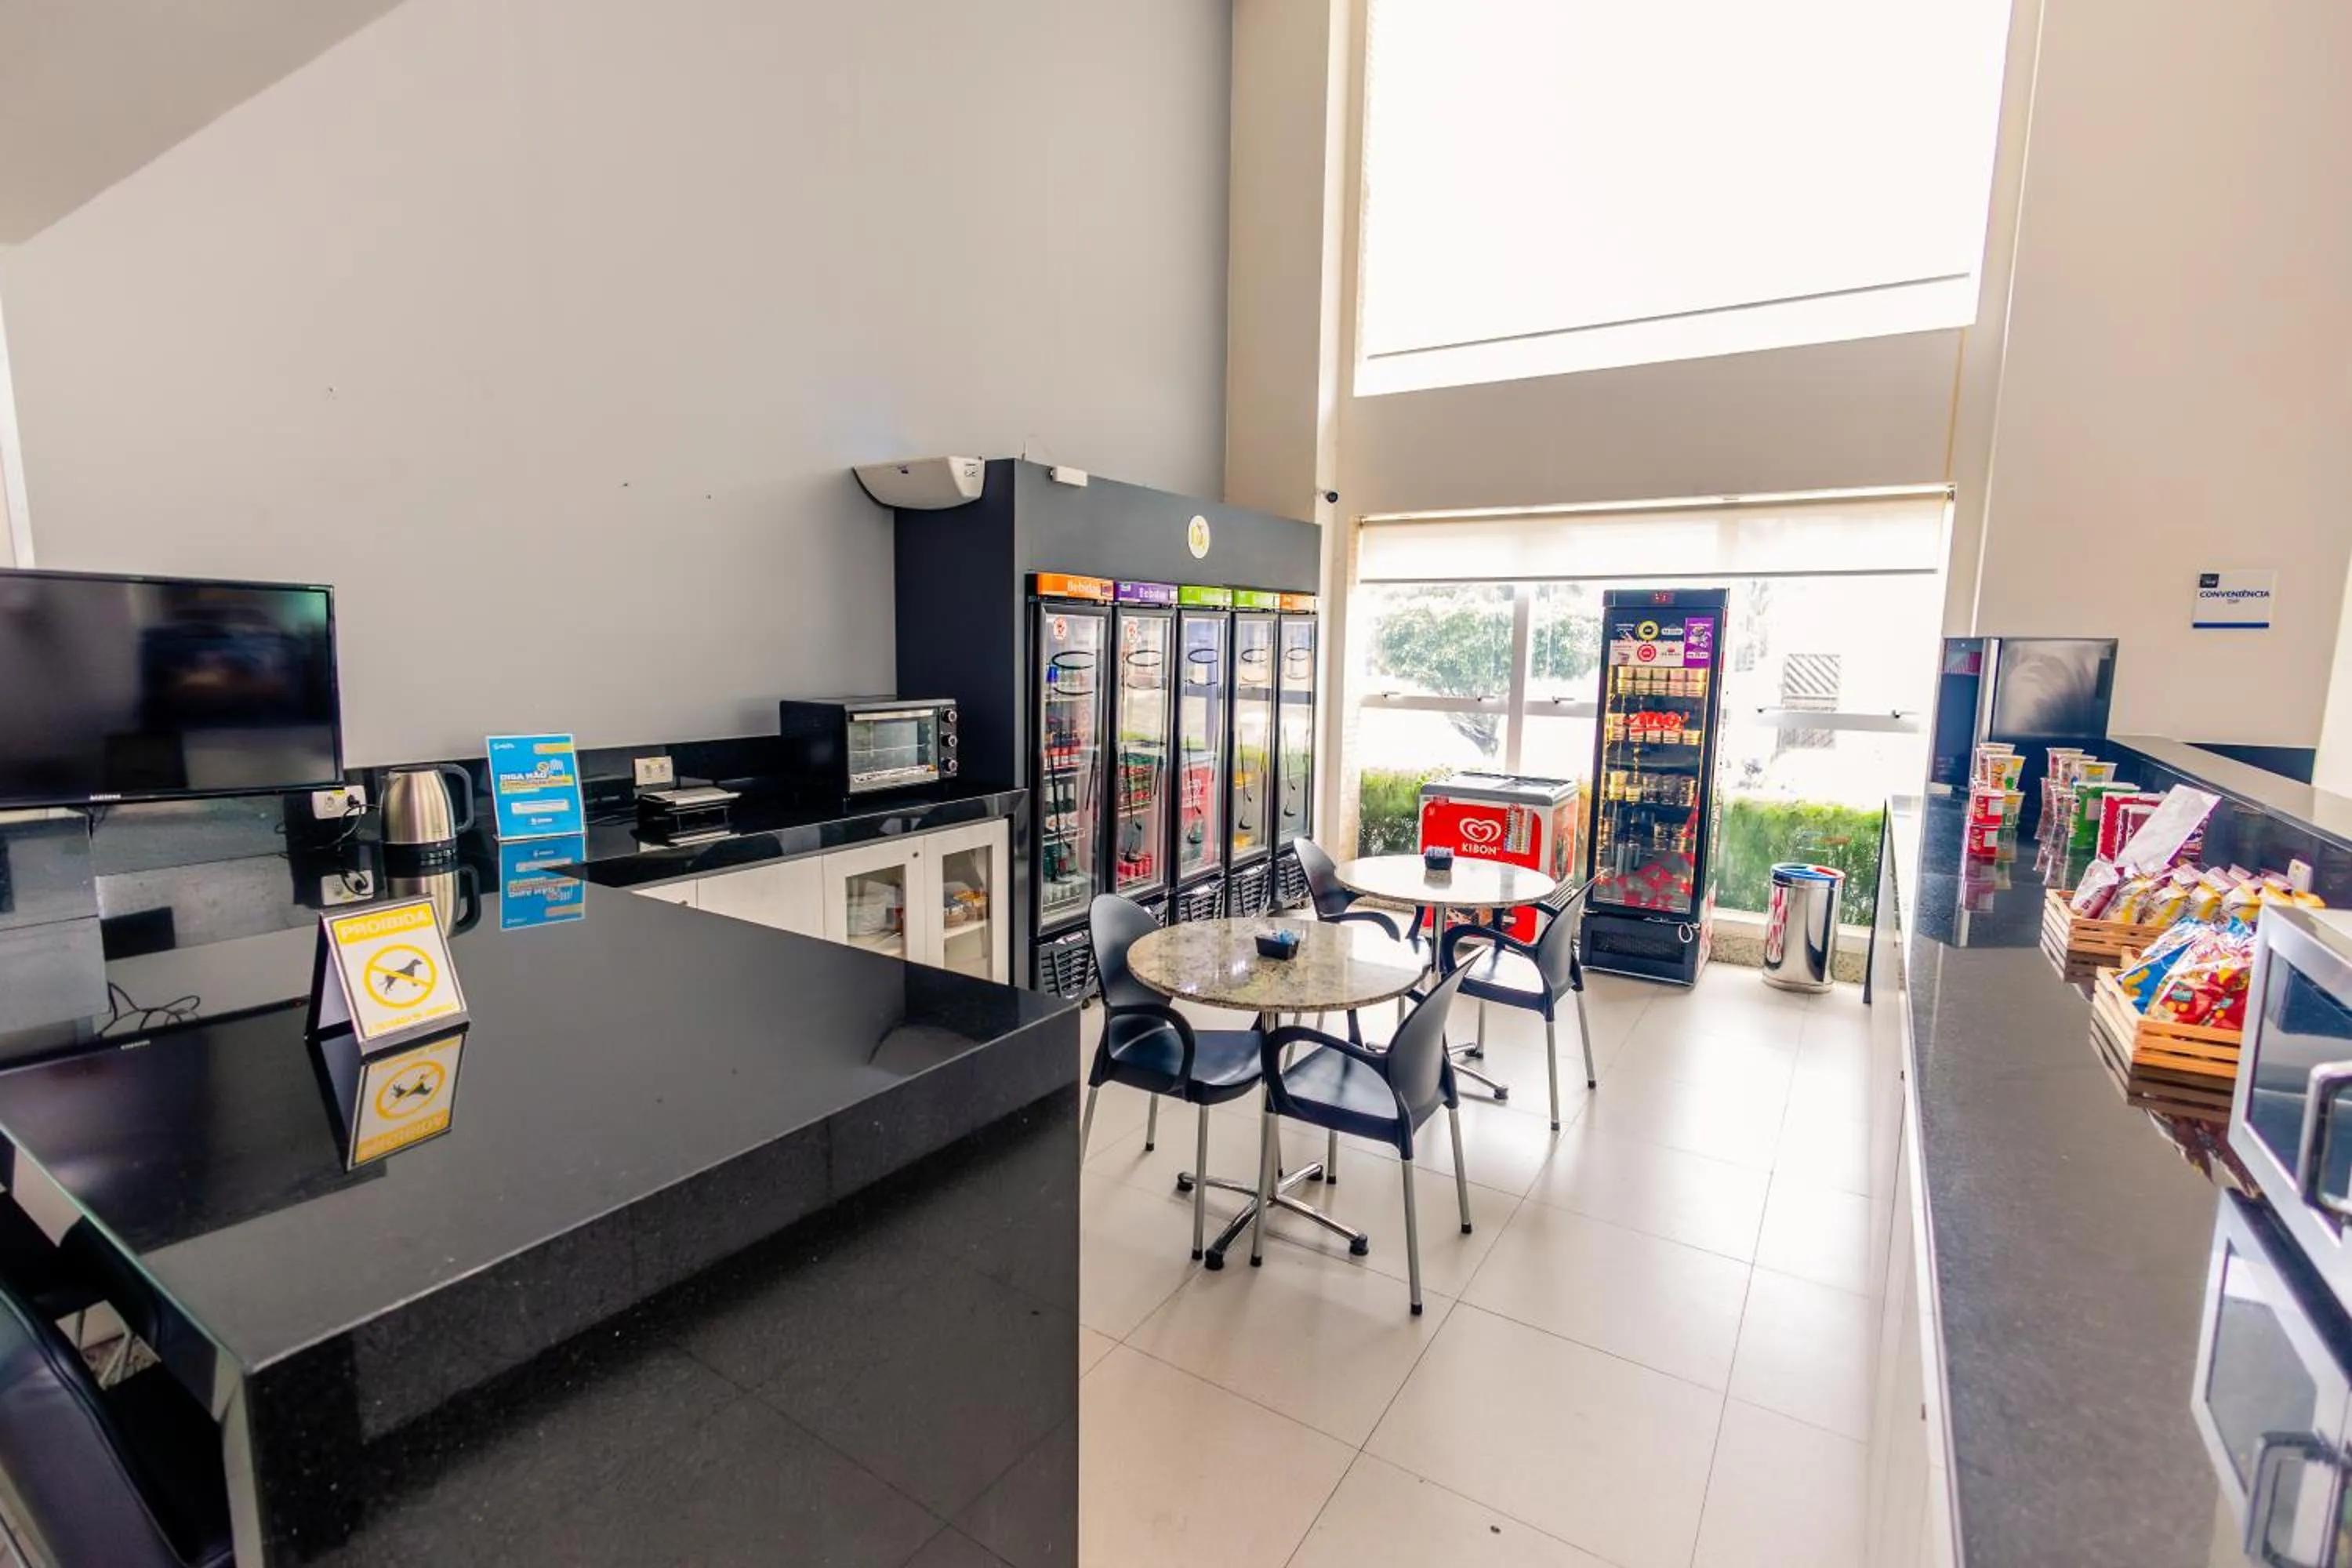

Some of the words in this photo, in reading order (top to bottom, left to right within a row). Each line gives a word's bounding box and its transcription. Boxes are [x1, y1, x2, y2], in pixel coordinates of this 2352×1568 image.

[2199, 590, 2270, 598] CONVENIÊNCIA
[1461, 842, 1497, 857] KIBON
[340, 909, 428, 939] PROIBIDA
